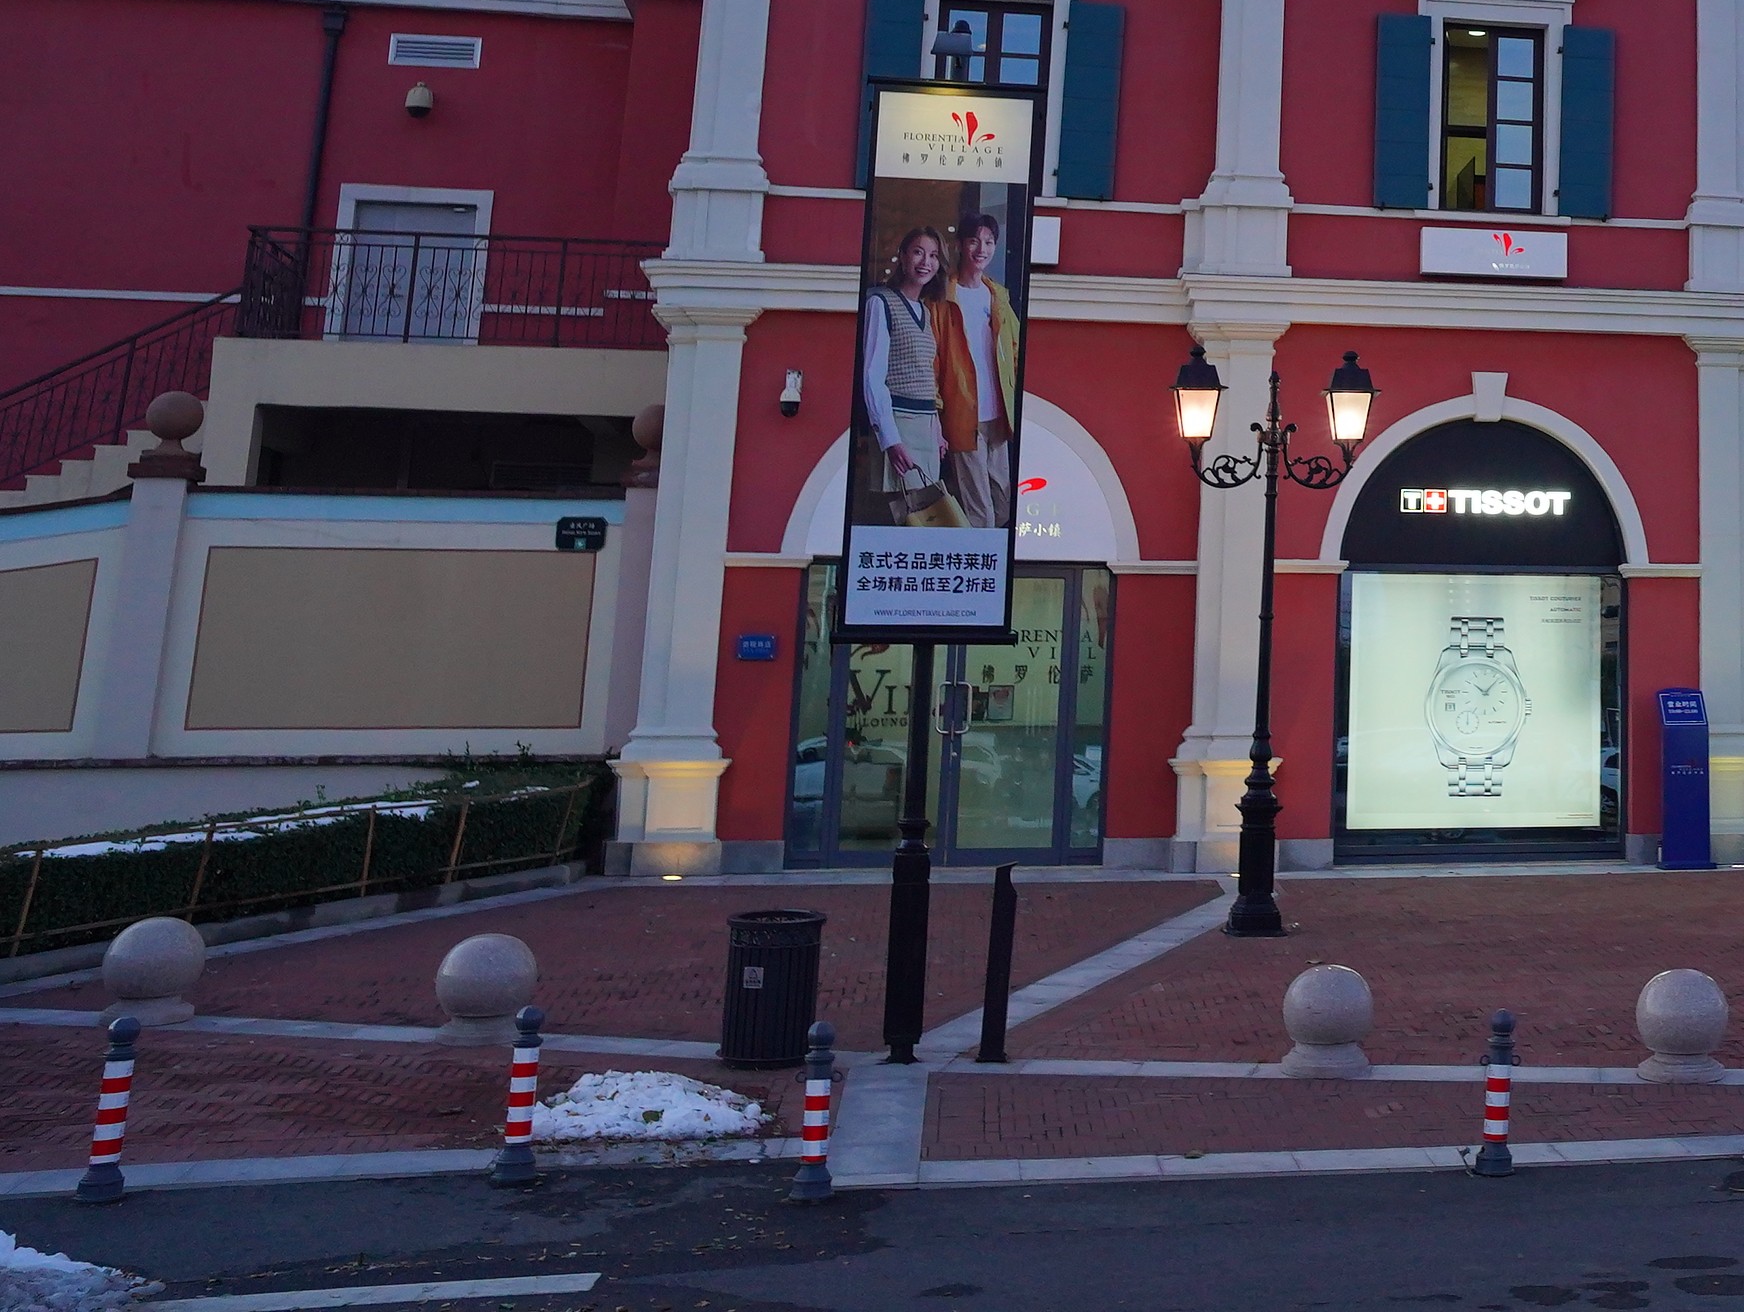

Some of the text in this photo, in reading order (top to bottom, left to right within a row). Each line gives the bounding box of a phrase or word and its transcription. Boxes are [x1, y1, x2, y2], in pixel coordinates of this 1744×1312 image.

[903, 132, 965, 144] FLORENTIA
[928, 143, 1004, 155] VILLAGE
[902, 152, 1003, 168] 佛罗伦萨小镇
[1448, 489, 1571, 515] TISSOT
[1015, 521, 1061, 538] 萨小镇
[858, 551, 998, 571] 意式名品奥特莱斯
[856, 575, 996, 593] 全场精品低至2折起
[862, 717, 908, 728] LOUNG
